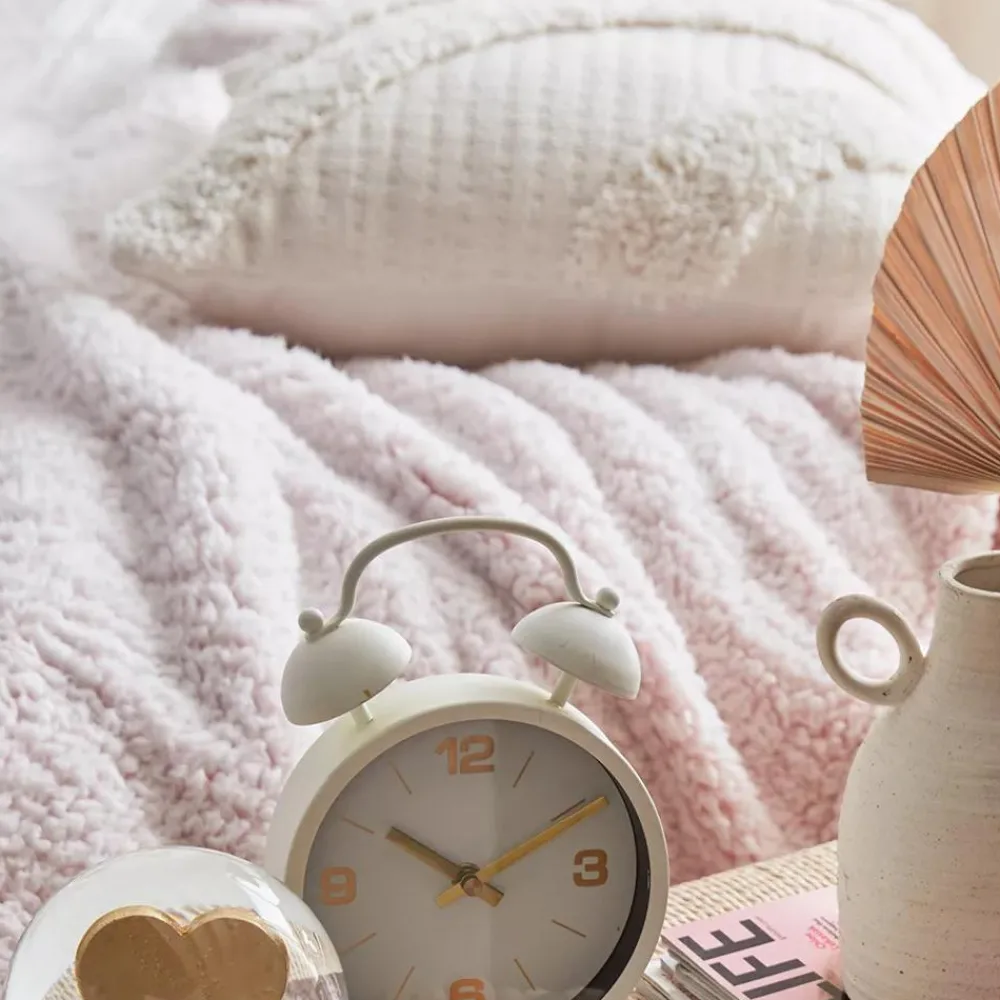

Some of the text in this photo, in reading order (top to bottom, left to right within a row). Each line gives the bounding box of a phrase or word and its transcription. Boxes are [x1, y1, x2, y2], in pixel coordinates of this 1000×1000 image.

[434, 735, 495, 775] 12
[320, 866, 357, 906] 9
[573, 849, 609, 887] 3
